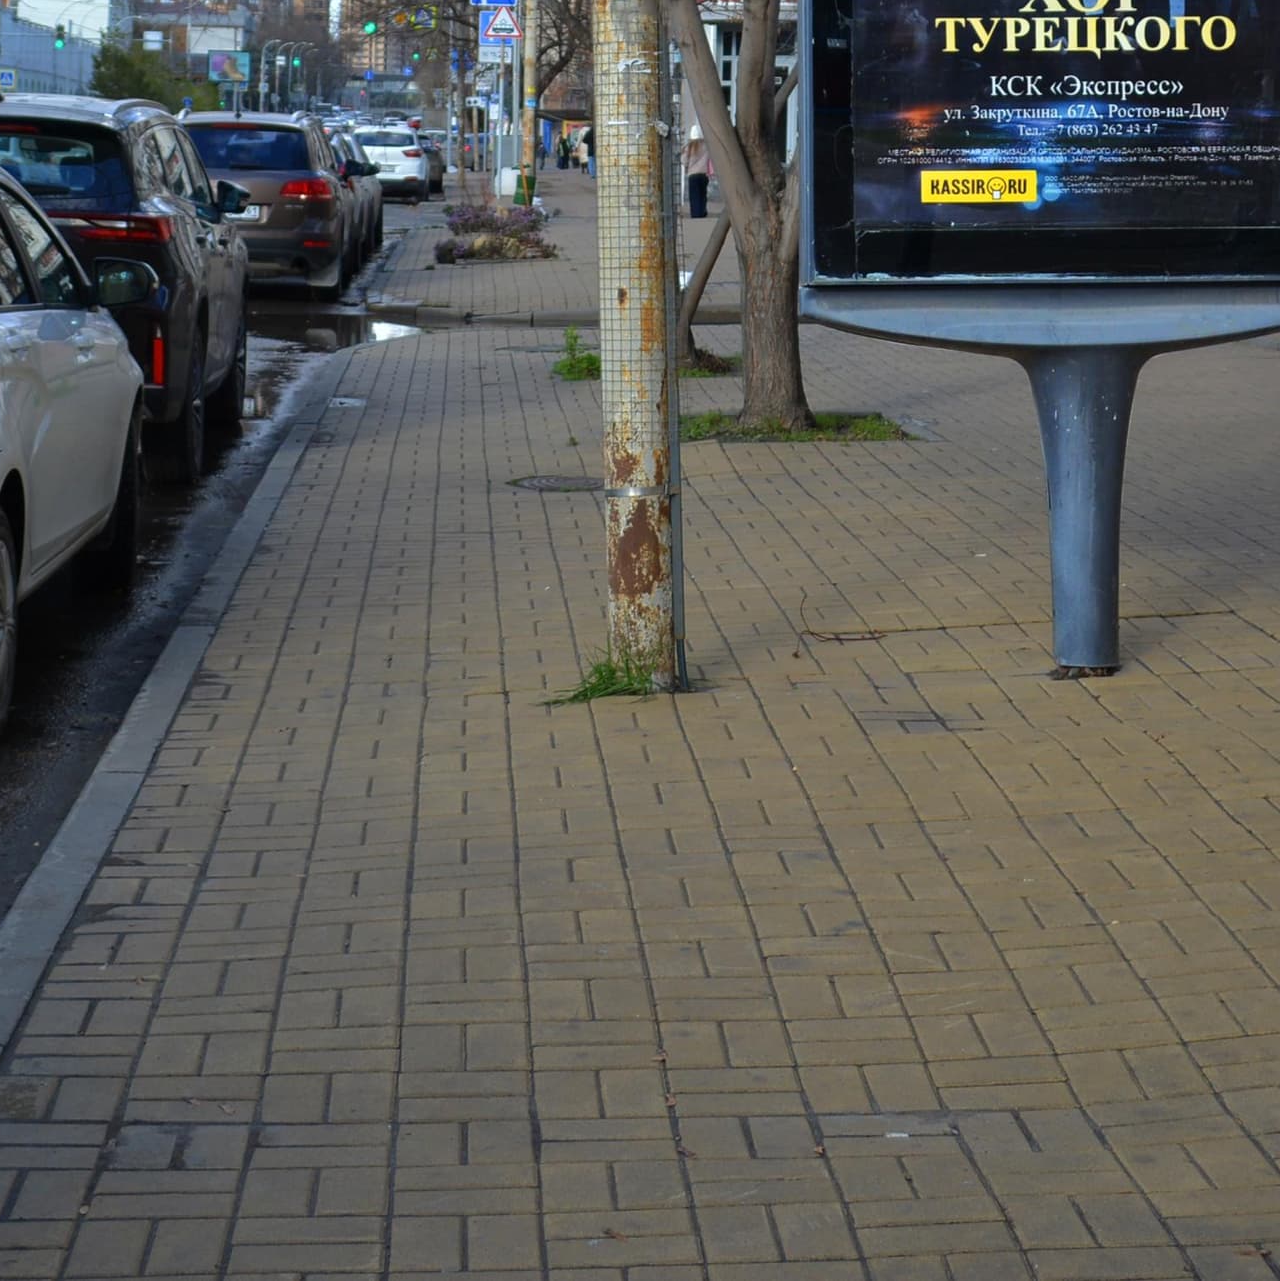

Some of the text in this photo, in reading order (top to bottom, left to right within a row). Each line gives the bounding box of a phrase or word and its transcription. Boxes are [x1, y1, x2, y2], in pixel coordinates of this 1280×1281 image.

[934, 16, 1237, 60] ТУРЕЦКОГО
[990, 74, 1184, 100] КСК «Экспресс»
[943, 103, 1230, 123] ул. Закруткина, 67А, Ростов-на-Дону
[1067, 123, 1099, 137] (863)
[1101, 123, 1123, 136] 262
[1142, 123, 1159, 135] 47
[930, 178, 987, 196] KASSIR
[1007, 178, 1027, 195] RU
